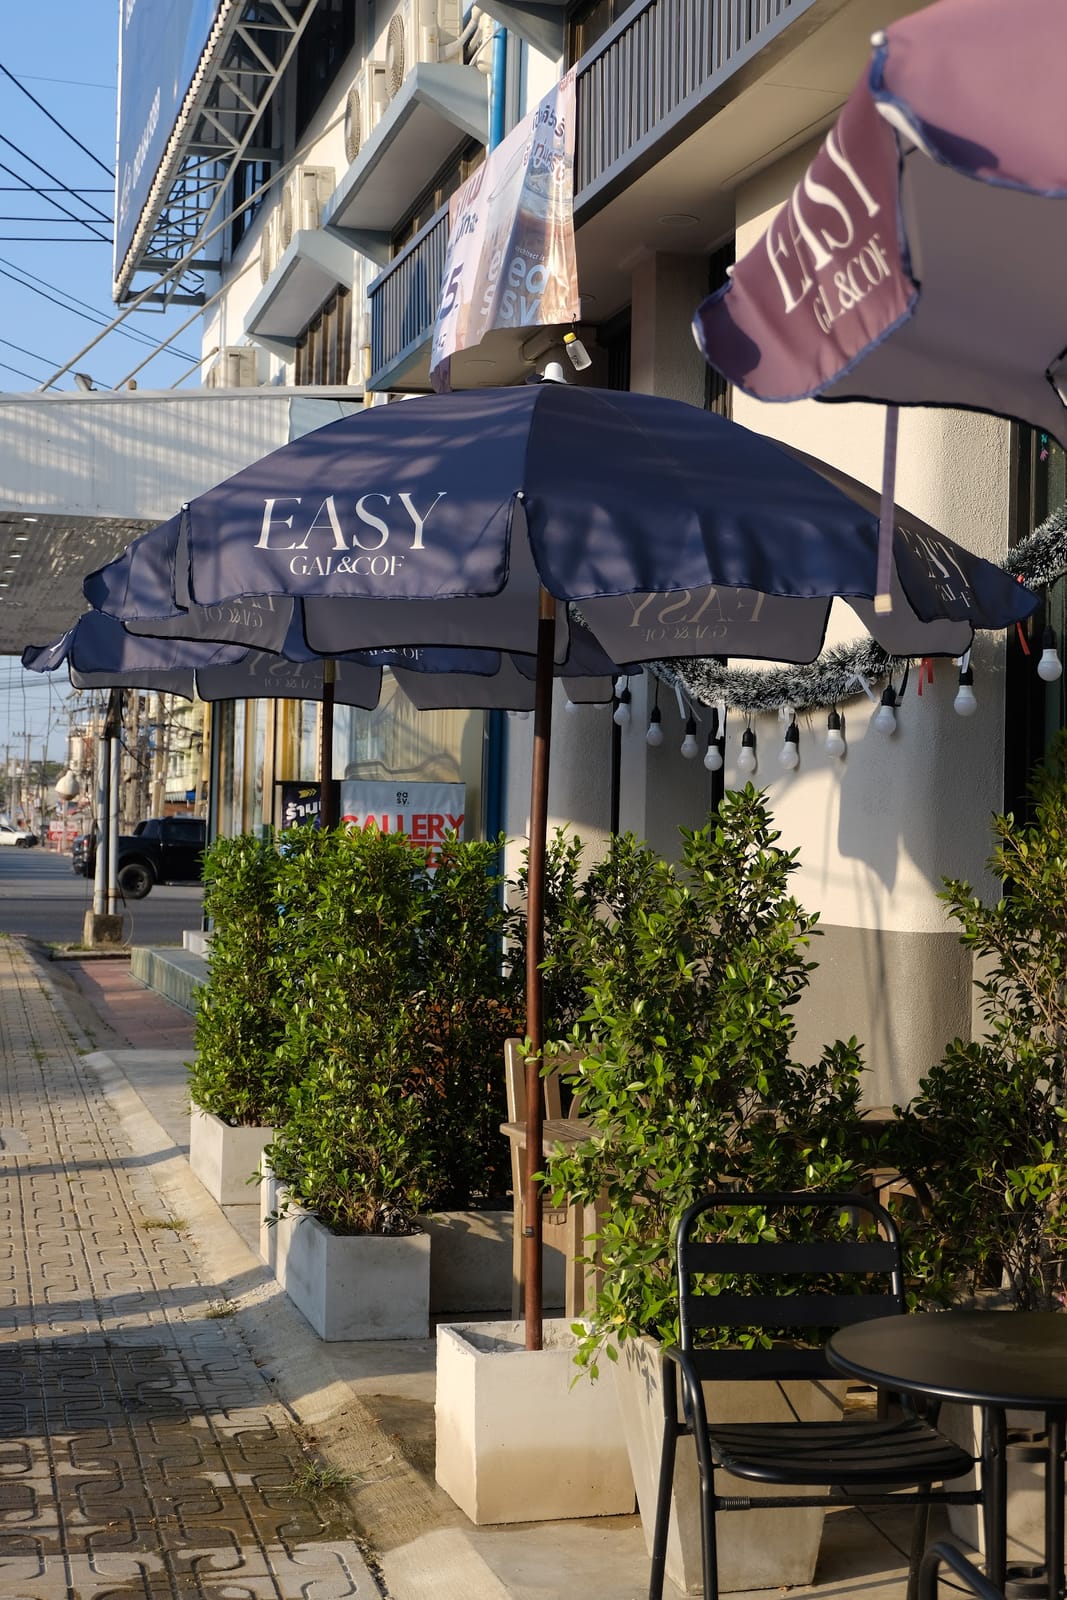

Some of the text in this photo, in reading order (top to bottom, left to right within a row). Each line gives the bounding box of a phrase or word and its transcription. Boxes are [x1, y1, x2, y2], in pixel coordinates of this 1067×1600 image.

[766, 125, 880, 314] EASY
[508, 256, 549, 295] ea
[253, 491, 447, 551] EASY
[286, 801, 321, 820] ร้าน
